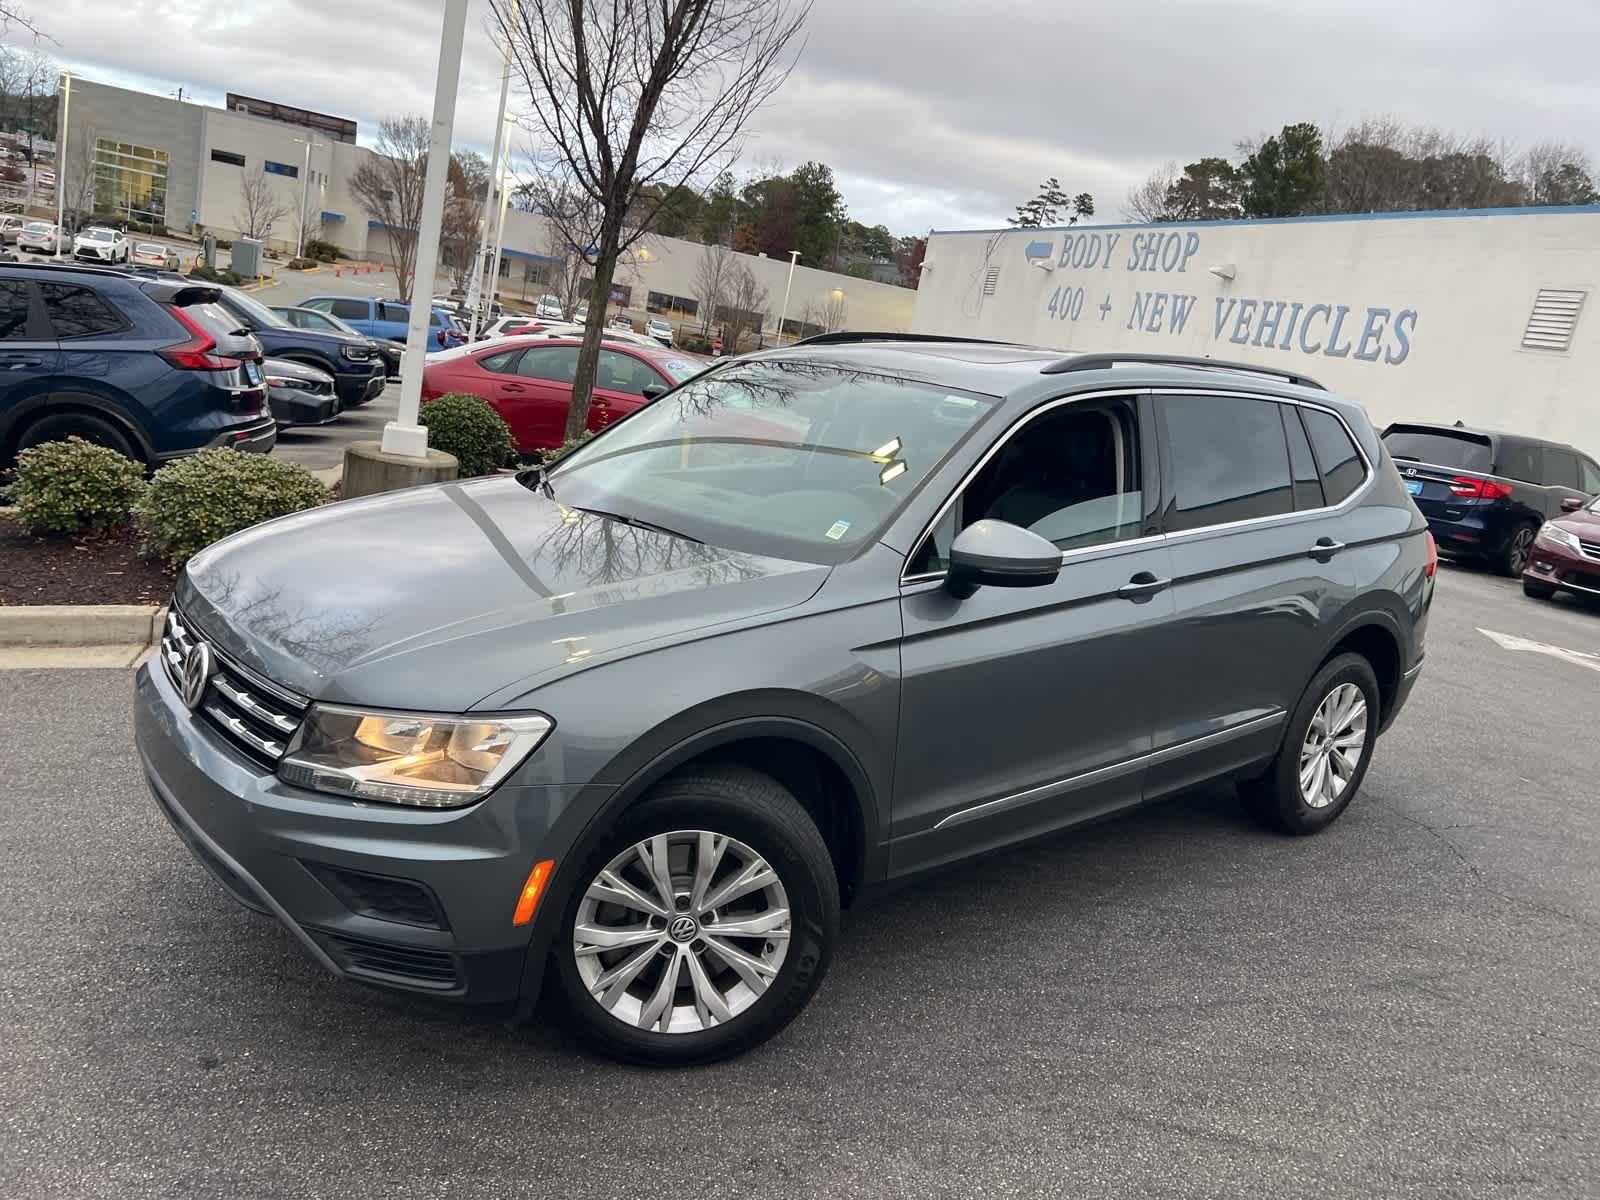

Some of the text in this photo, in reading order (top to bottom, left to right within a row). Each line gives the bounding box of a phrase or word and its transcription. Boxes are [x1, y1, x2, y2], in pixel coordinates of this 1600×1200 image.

[1057, 231, 1200, 272] BODY SHOP
[1048, 285, 1084, 321] 400
[1127, 291, 1197, 336] NEW
[1213, 297, 1418, 365] VEHICLES
